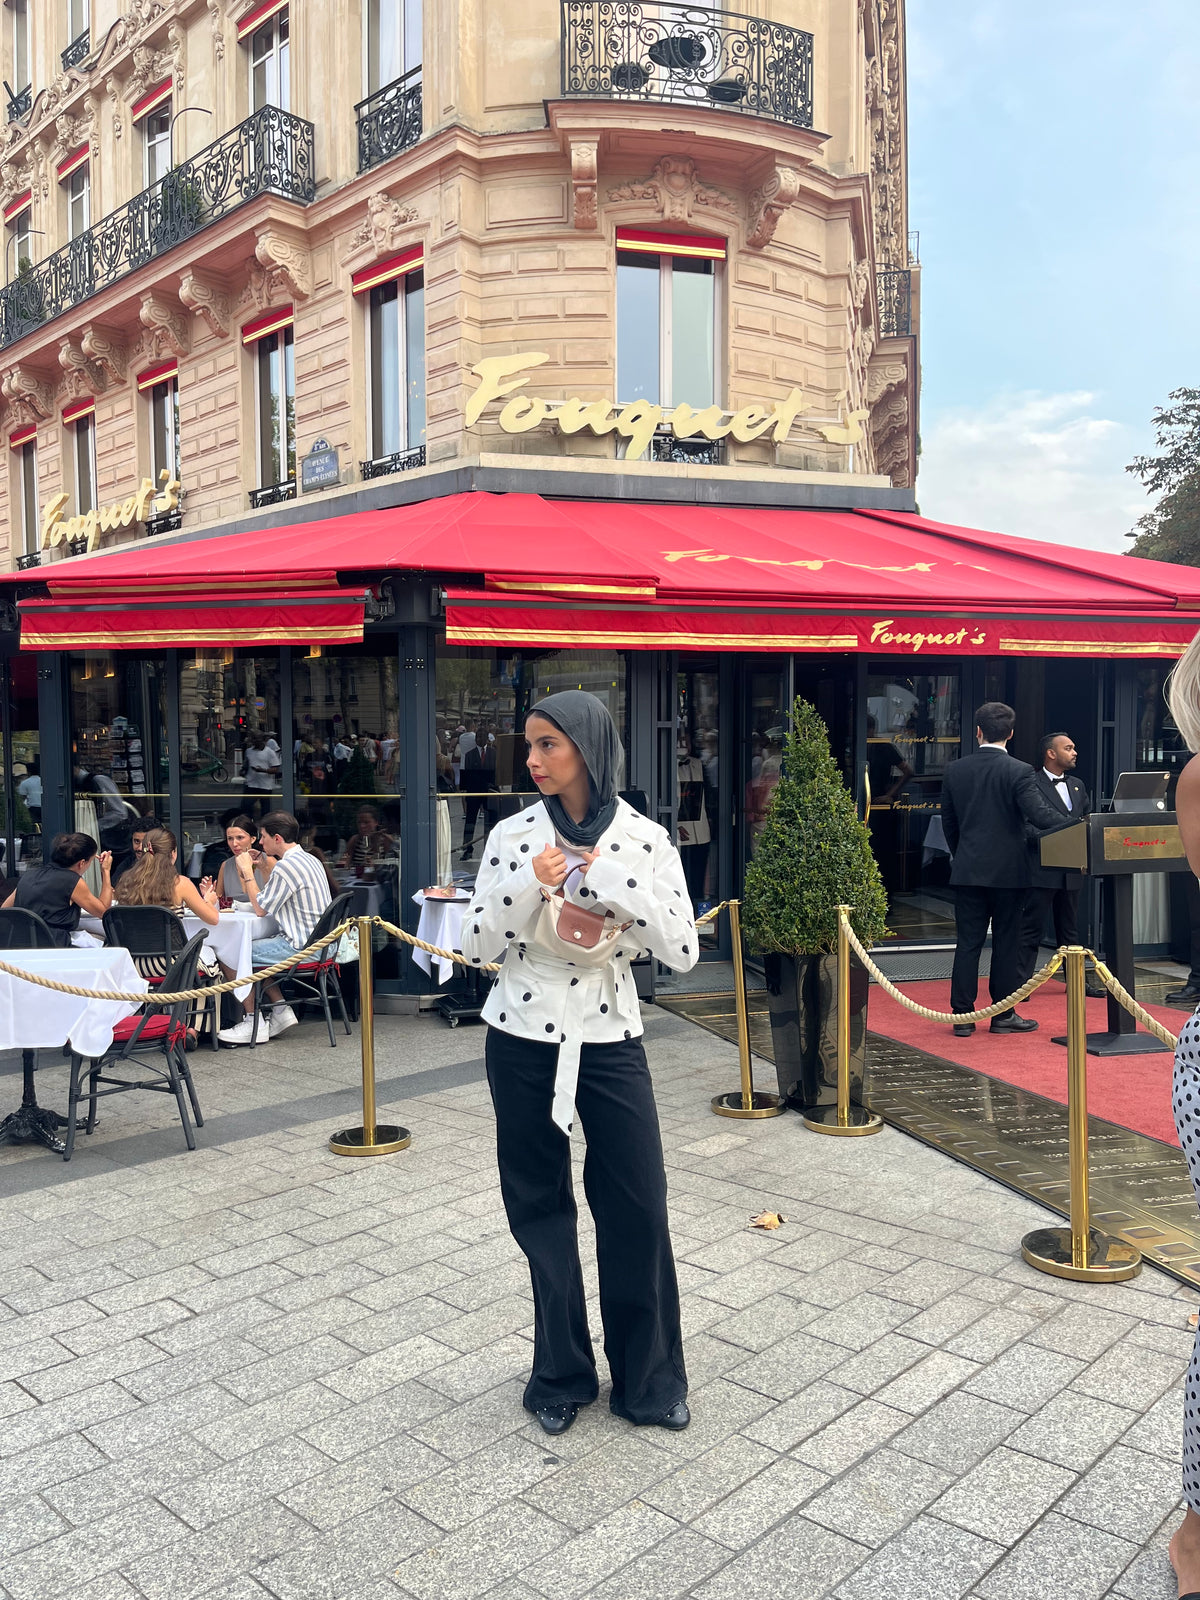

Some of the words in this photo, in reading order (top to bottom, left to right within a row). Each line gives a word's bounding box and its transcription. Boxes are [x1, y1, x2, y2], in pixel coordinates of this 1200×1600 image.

[465, 351, 870, 460] Fouquet's
[41, 469, 181, 553] Fouquet's
[870, 619, 987, 652] Fouquet's
[893, 733, 936, 745] Fouquet's
[892, 800, 934, 812] Fouquet's
